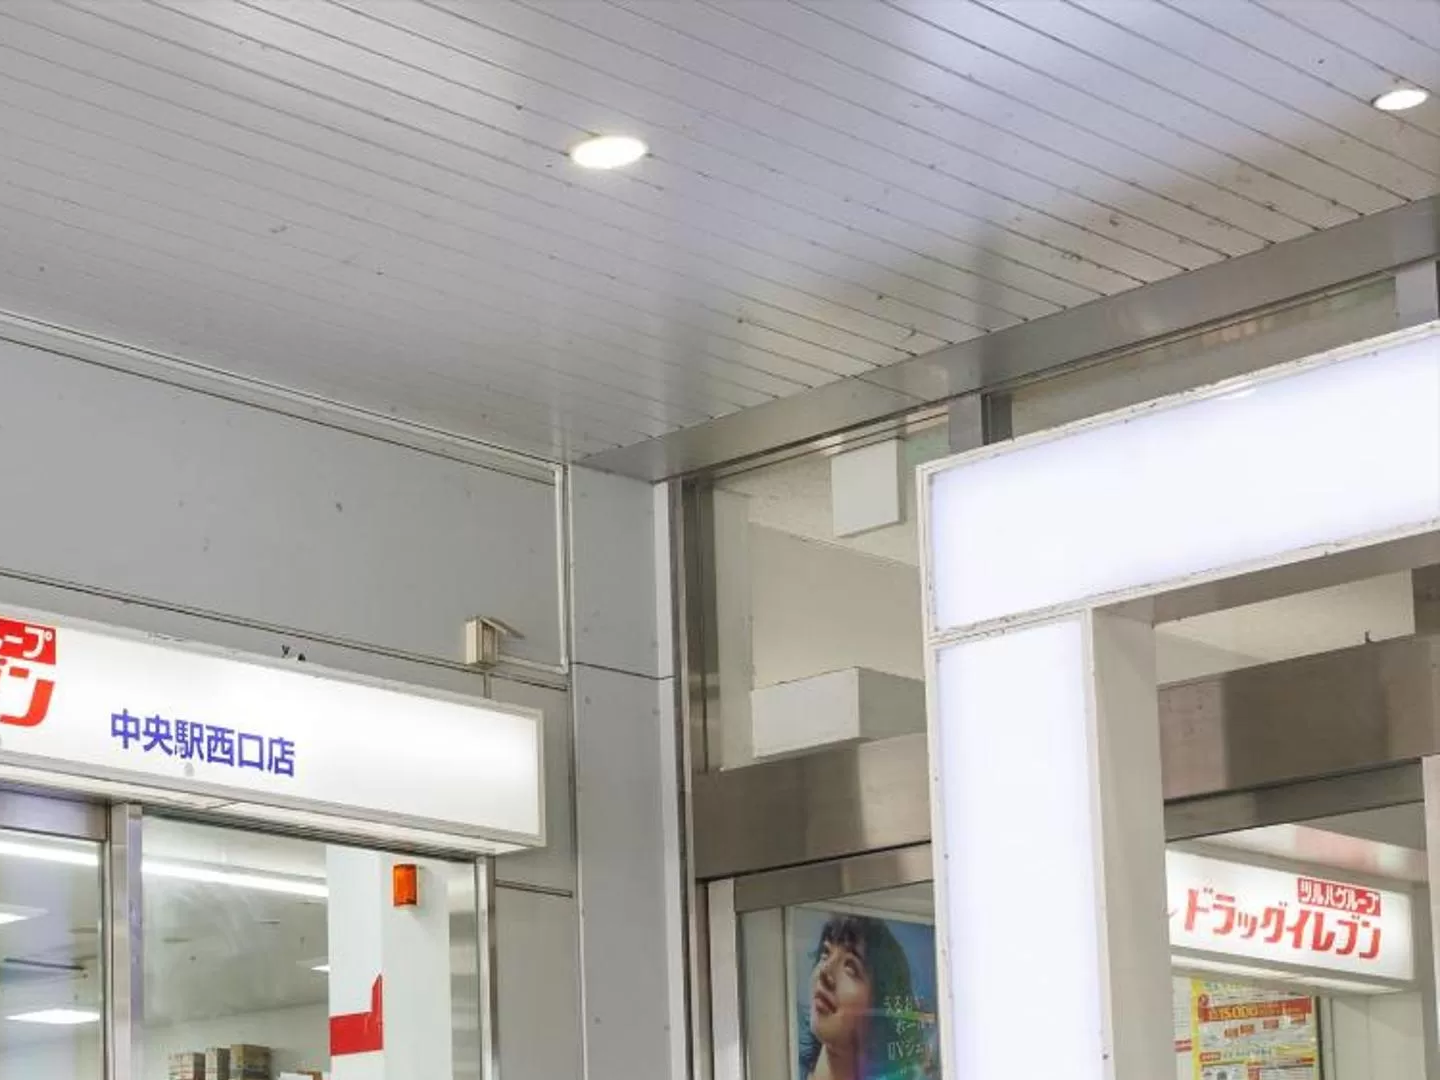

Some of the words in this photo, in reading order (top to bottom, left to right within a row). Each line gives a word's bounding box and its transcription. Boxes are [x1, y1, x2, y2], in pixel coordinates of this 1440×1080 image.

[110, 708, 295, 777] 中央駅西口店
[1183, 887, 1381, 962] ドラッグイレブン
[1302, 881, 1378, 915] ツルハグループ
